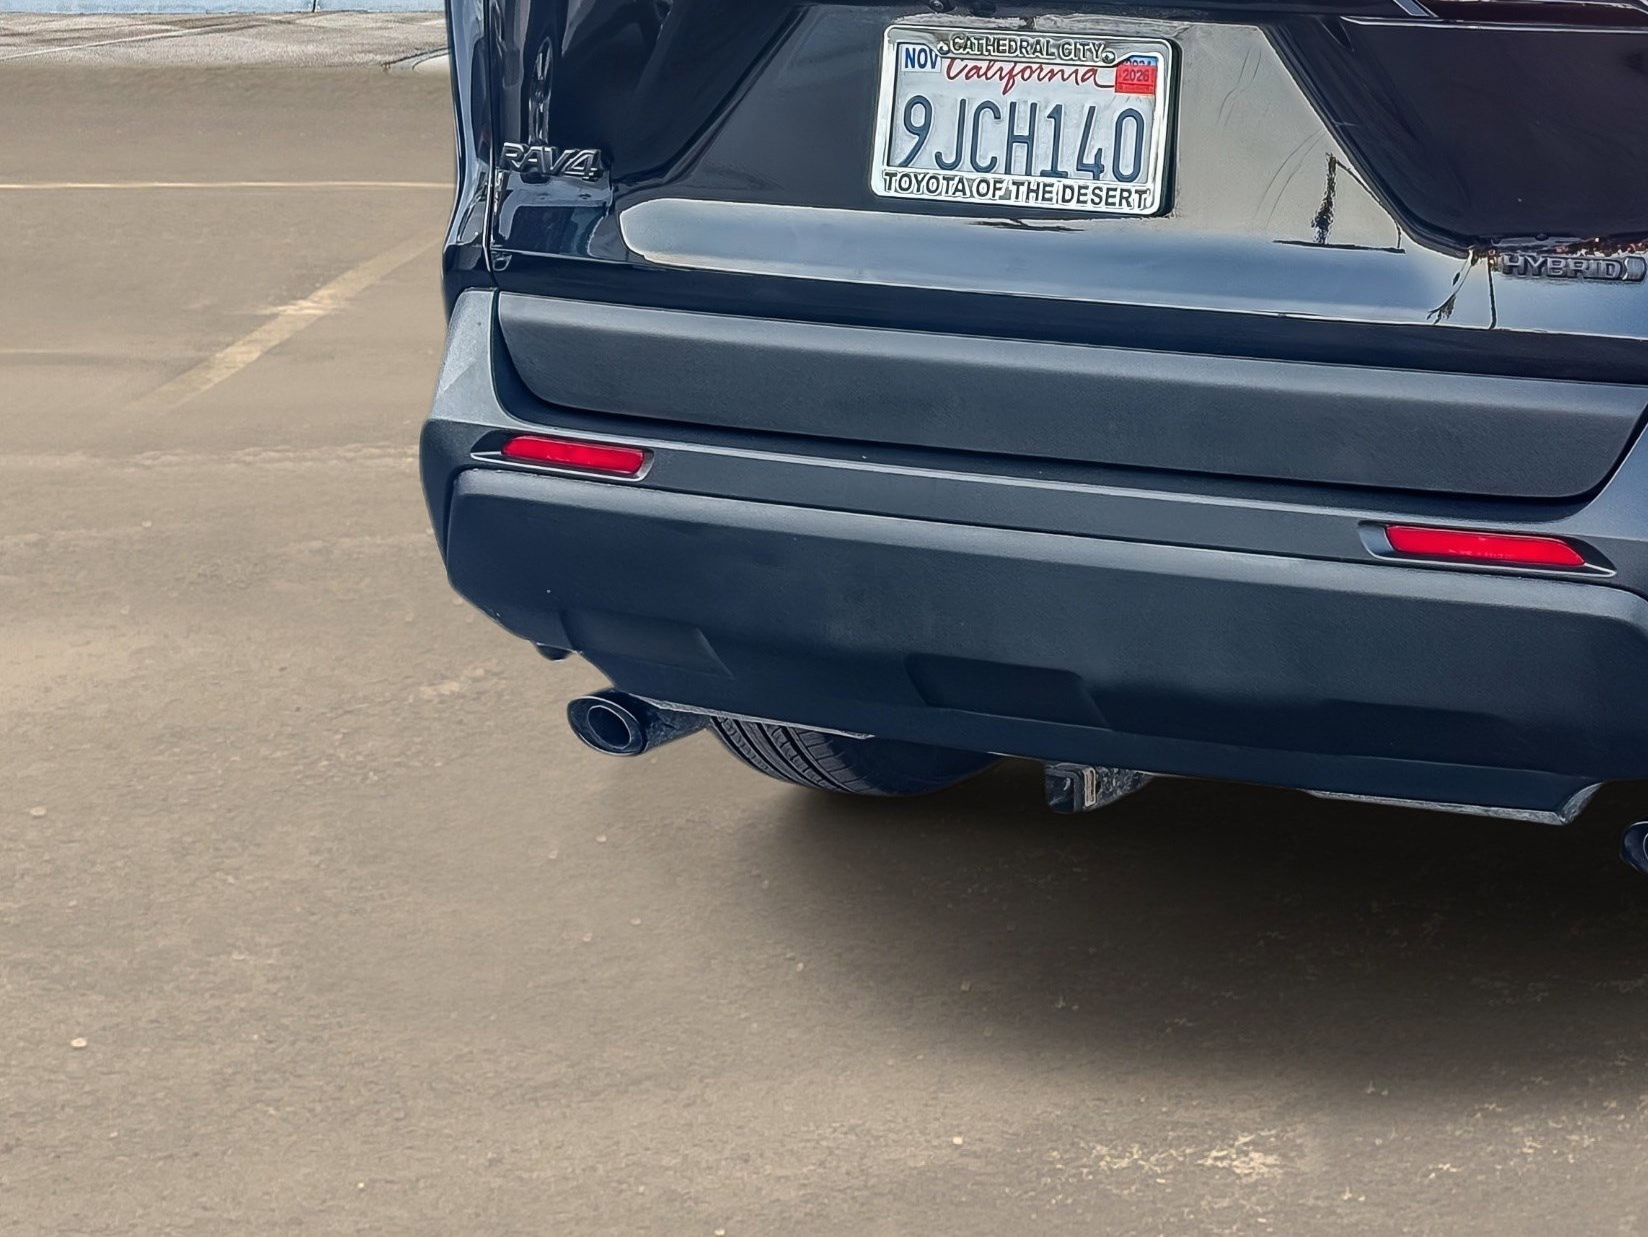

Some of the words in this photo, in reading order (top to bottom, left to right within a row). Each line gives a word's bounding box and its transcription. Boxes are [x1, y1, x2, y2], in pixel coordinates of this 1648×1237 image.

[905, 47, 938, 70] NOV
[951, 35, 1055, 59] CATHEDRAL
[1060, 41, 1105, 60] CITY
[946, 57, 1114, 95] California
[1122, 69, 1150, 82] 2026
[899, 95, 1145, 183] 9JCH140
[501, 142, 602, 182] RAV4
[883, 171, 968, 197] TOYOTA
[976, 178, 1005, 199] OF
[1012, 181, 1054, 203] THE
[1061, 183, 1148, 209] DESERT
[1502, 253, 1623, 280] HYBRID
